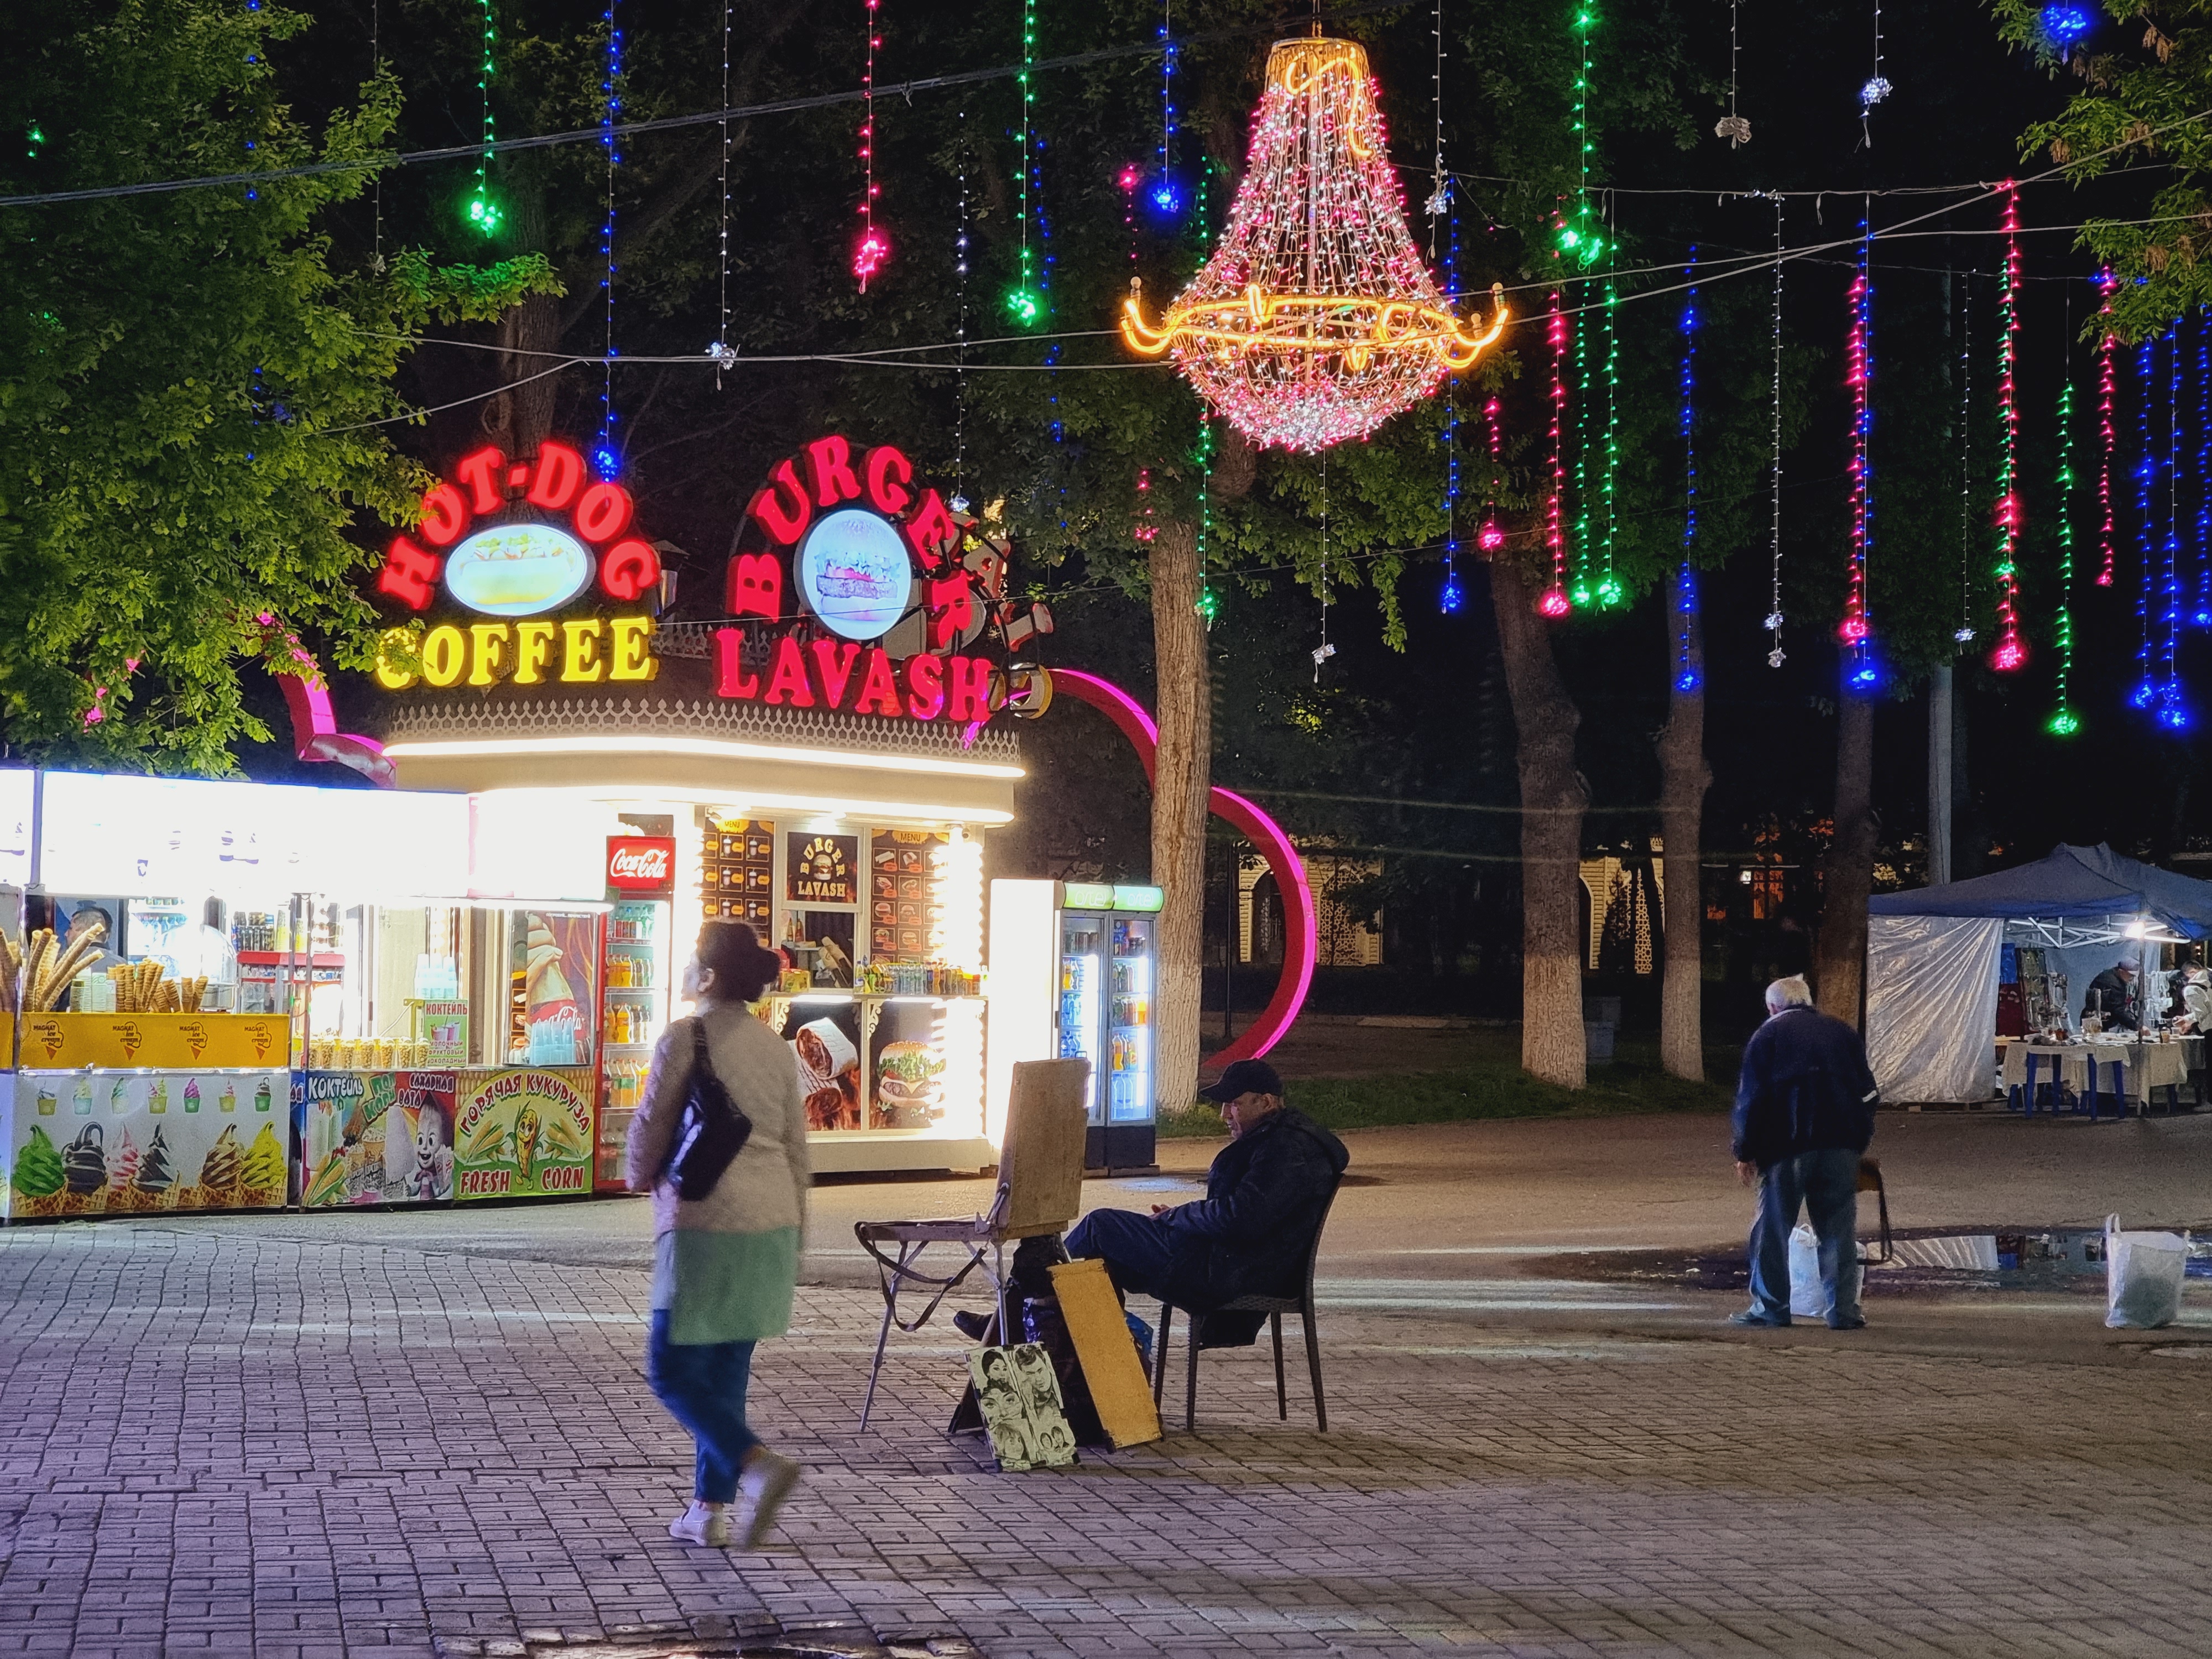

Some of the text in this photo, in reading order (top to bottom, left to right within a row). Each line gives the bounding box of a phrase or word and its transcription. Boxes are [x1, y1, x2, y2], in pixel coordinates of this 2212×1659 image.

[380, 442, 658, 610] HOT-DOG
[735, 435, 973, 649] BURGER
[375, 617, 654, 688] COFFEE
[716, 629, 993, 721] LAVASH
[800, 837, 845, 877] BURGER
[900, 833, 921, 842] MENU
[798, 881, 846, 897] LAVASH
[426, 1002, 467, 1015] КОКТЕЙЛЬ
[307, 1073, 363, 1100] КОКТЕЙЛЬ
[460, 1073, 591, 1135] ГОРЯЧАЯ КУКУРУЗА
[460, 1166, 585, 1193] FRESH CORN
